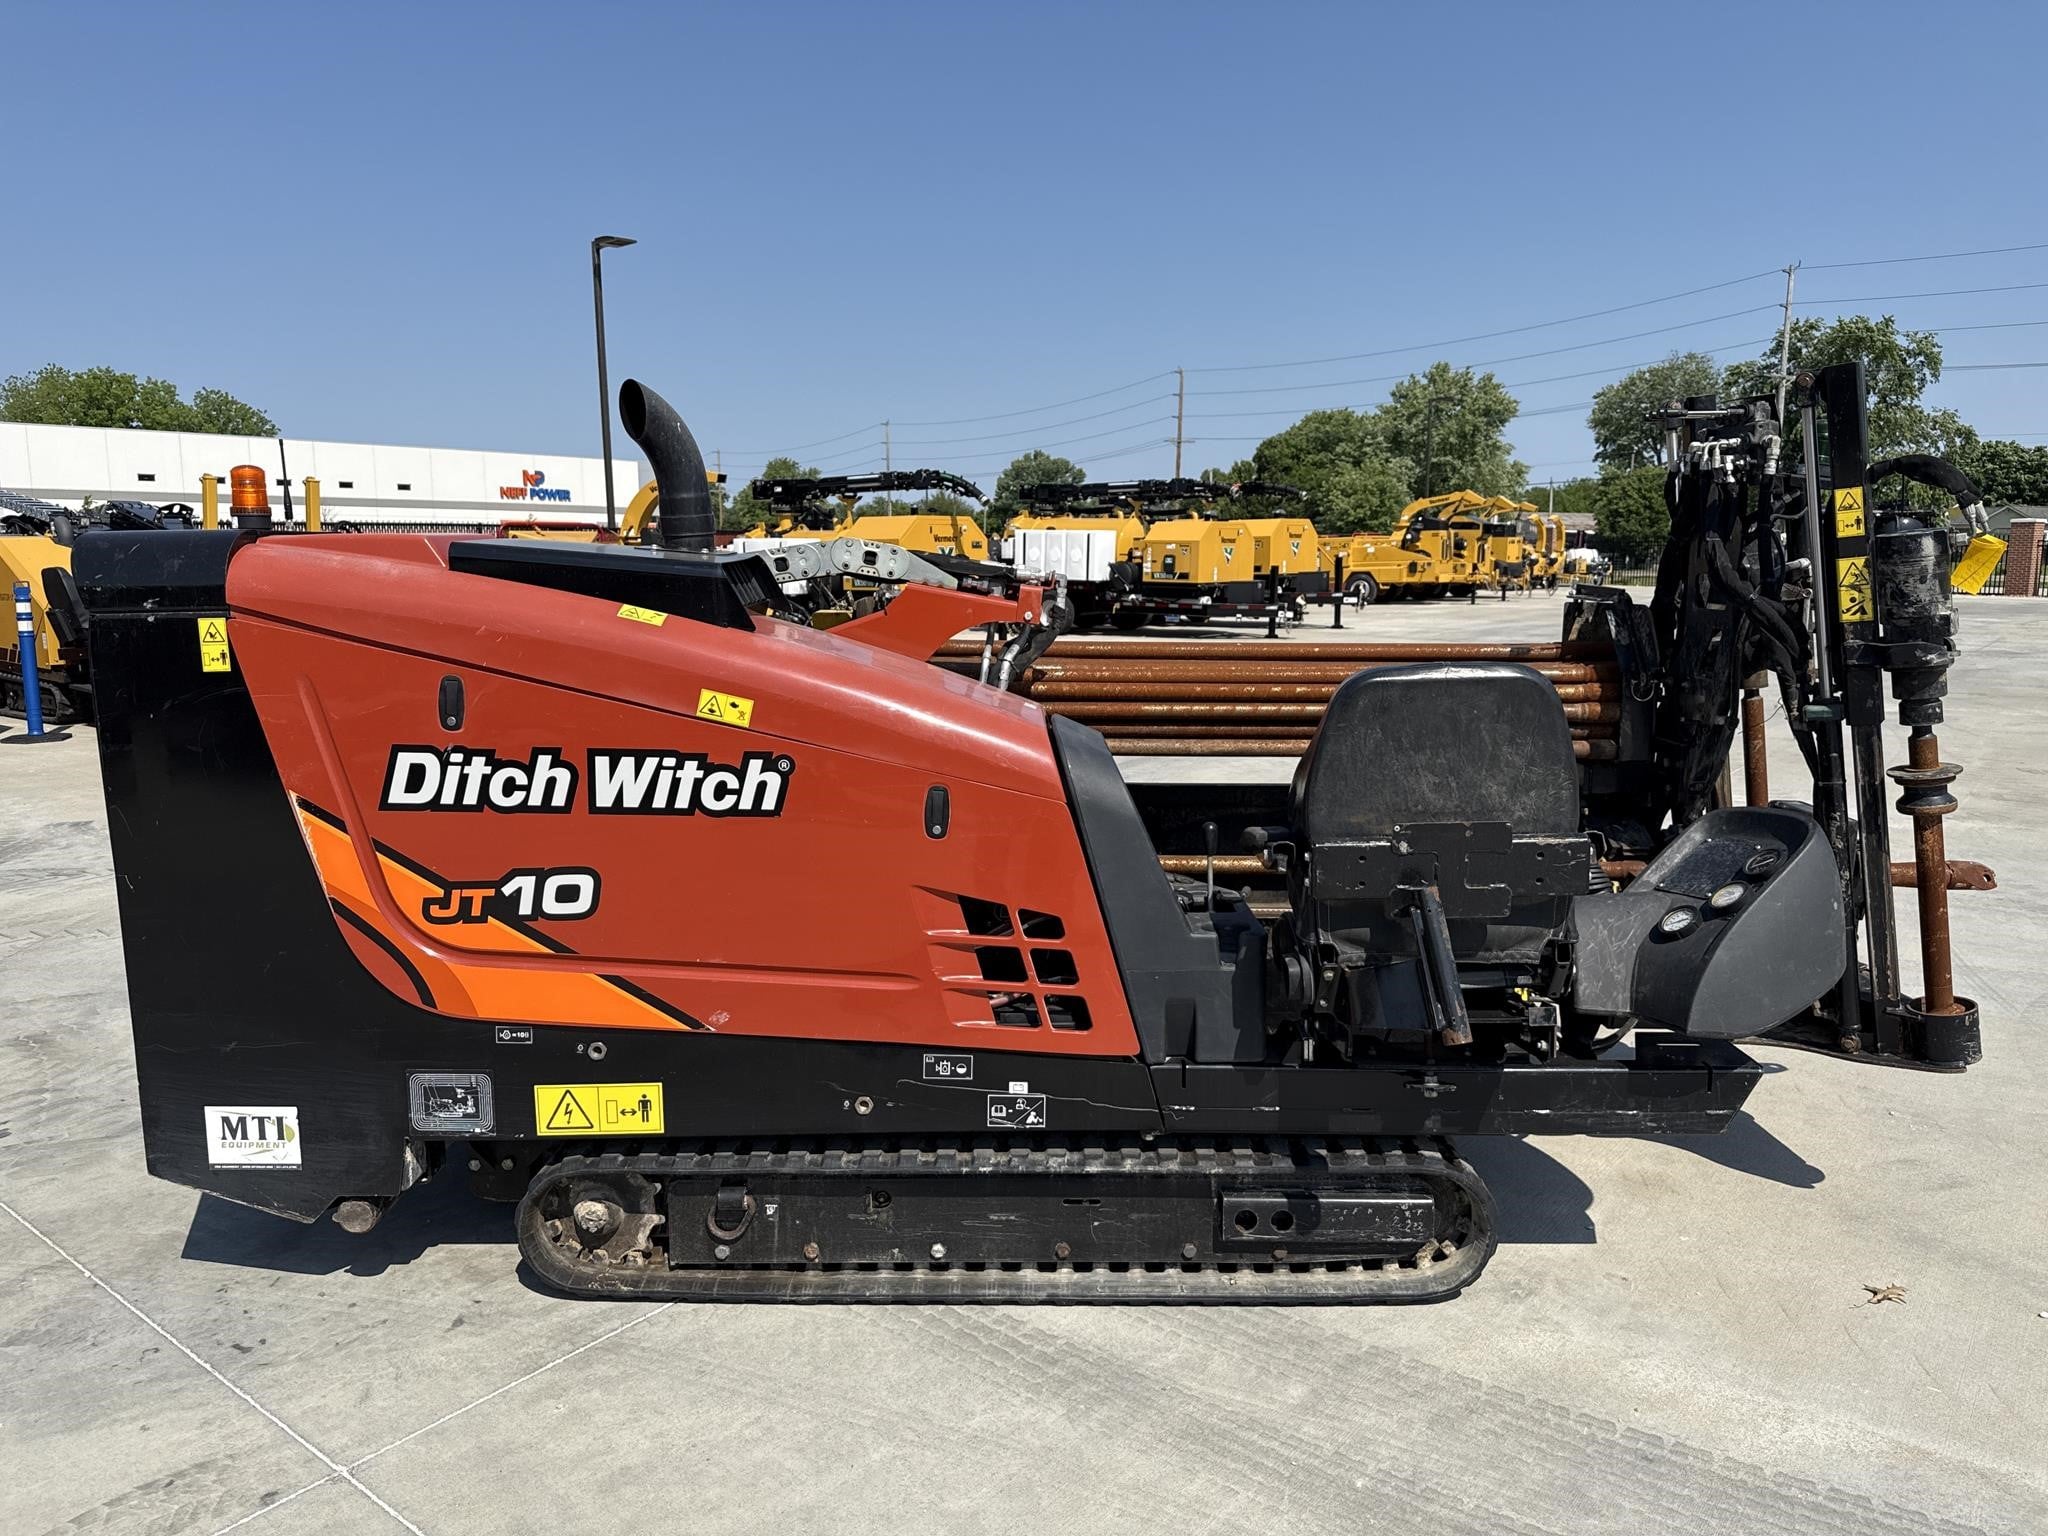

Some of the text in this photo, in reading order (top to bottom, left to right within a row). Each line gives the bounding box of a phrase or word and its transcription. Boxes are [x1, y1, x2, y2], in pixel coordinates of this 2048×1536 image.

[500, 486, 571, 502] NEFF POWER
[933, 533, 958, 543] Vermeer
[387, 750, 573, 807] Ditch
[429, 873, 596, 919] JT10
[220, 1115, 286, 1141] MTI
[220, 1141, 287, 1149] EQUIPMENT
